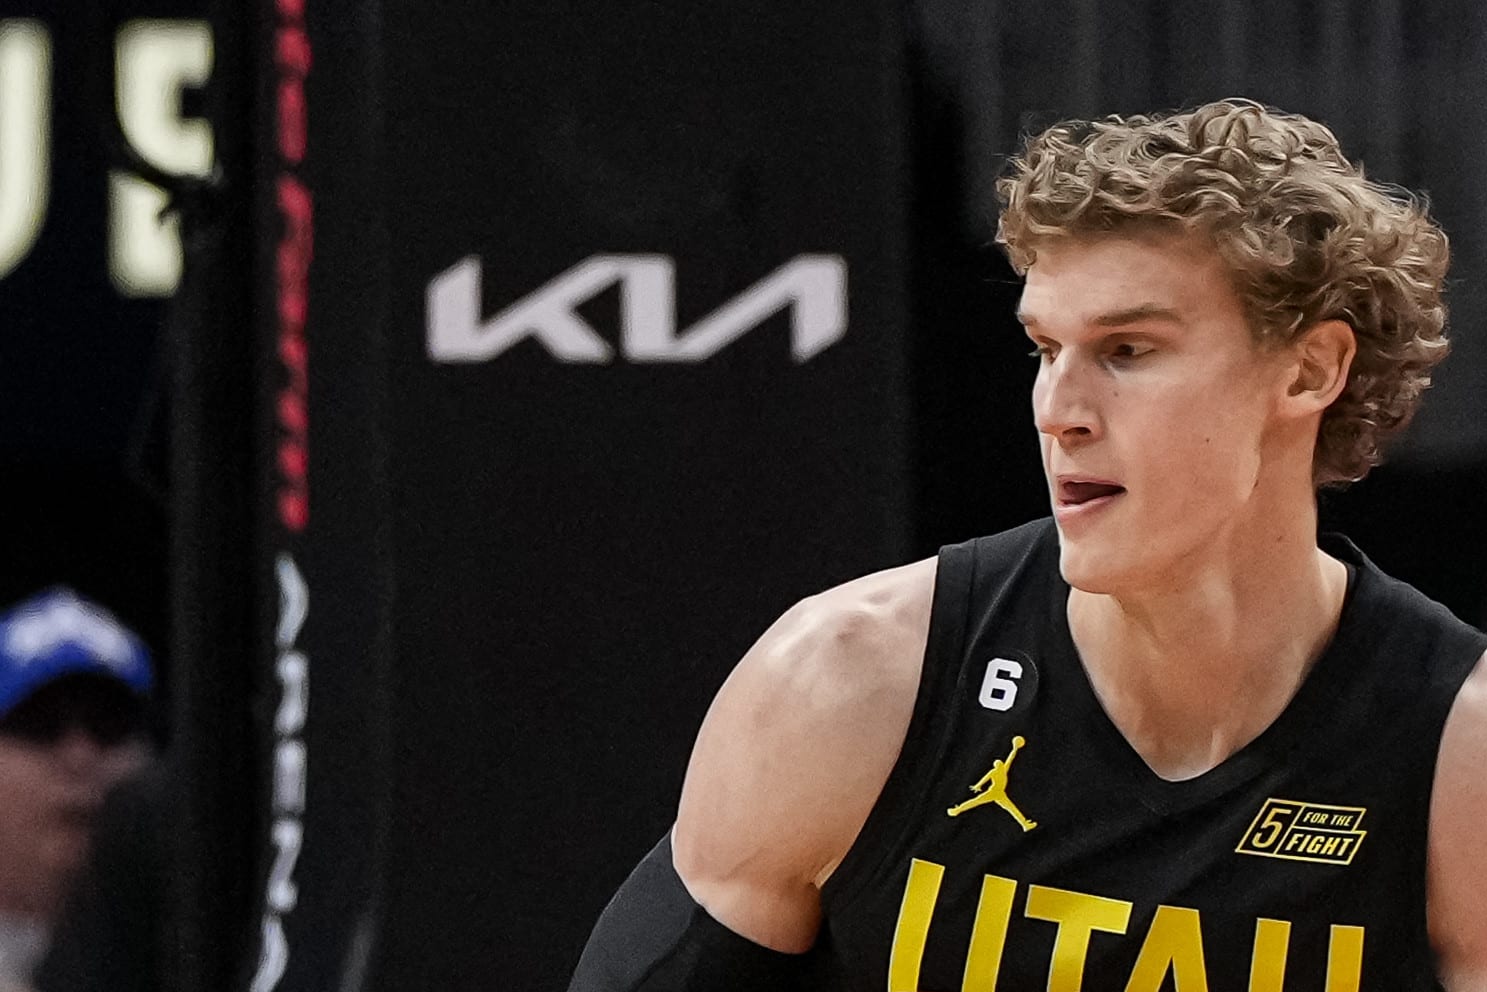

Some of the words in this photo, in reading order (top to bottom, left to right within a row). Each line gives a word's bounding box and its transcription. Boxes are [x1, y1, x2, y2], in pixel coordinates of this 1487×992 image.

[426, 252, 849, 365] KIA
[978, 657, 1023, 712] 6
[1251, 807, 1292, 849] 5
[1302, 811, 1329, 825] FOR
[1329, 814, 1354, 827] THE
[1285, 833, 1354, 857] FIGHT
